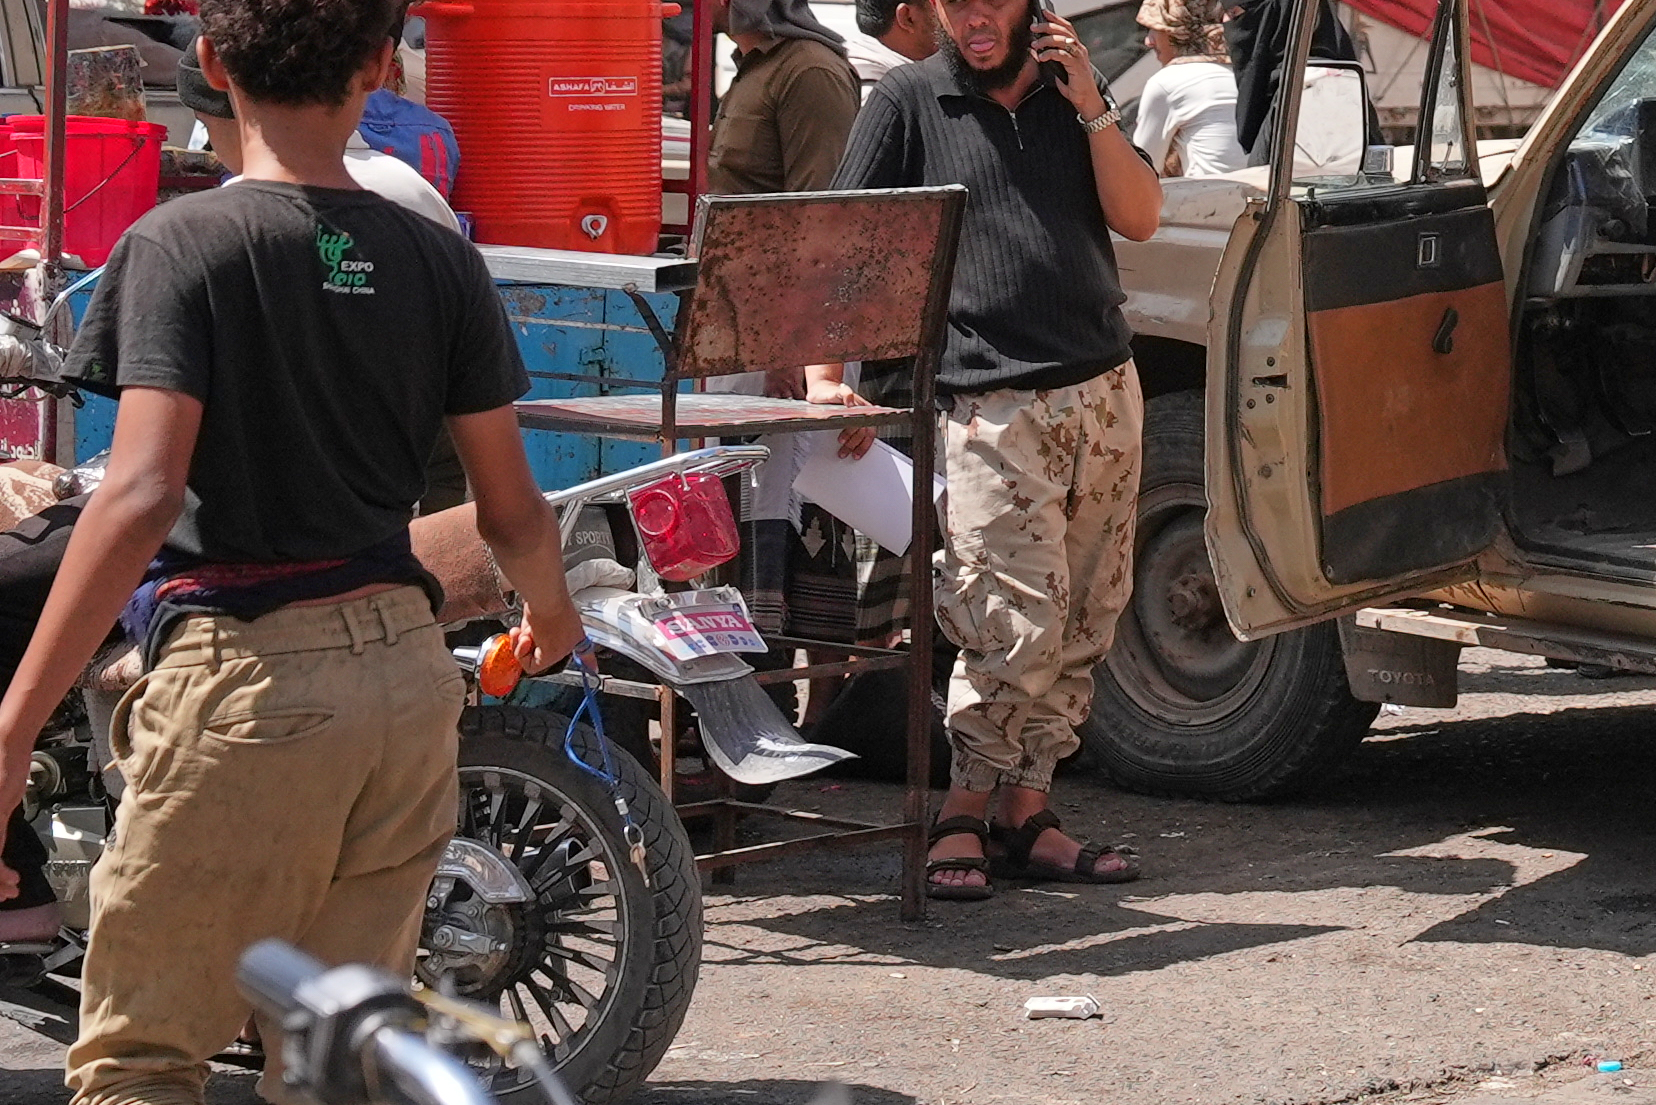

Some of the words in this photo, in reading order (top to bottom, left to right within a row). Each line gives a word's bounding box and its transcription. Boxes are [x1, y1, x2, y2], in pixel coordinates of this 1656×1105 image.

[553, 82, 589, 92] ASHAFA
[340, 260, 375, 273] EXPO
[665, 614, 743, 636] SANYA
[1367, 668, 1436, 687] TOYOTA
